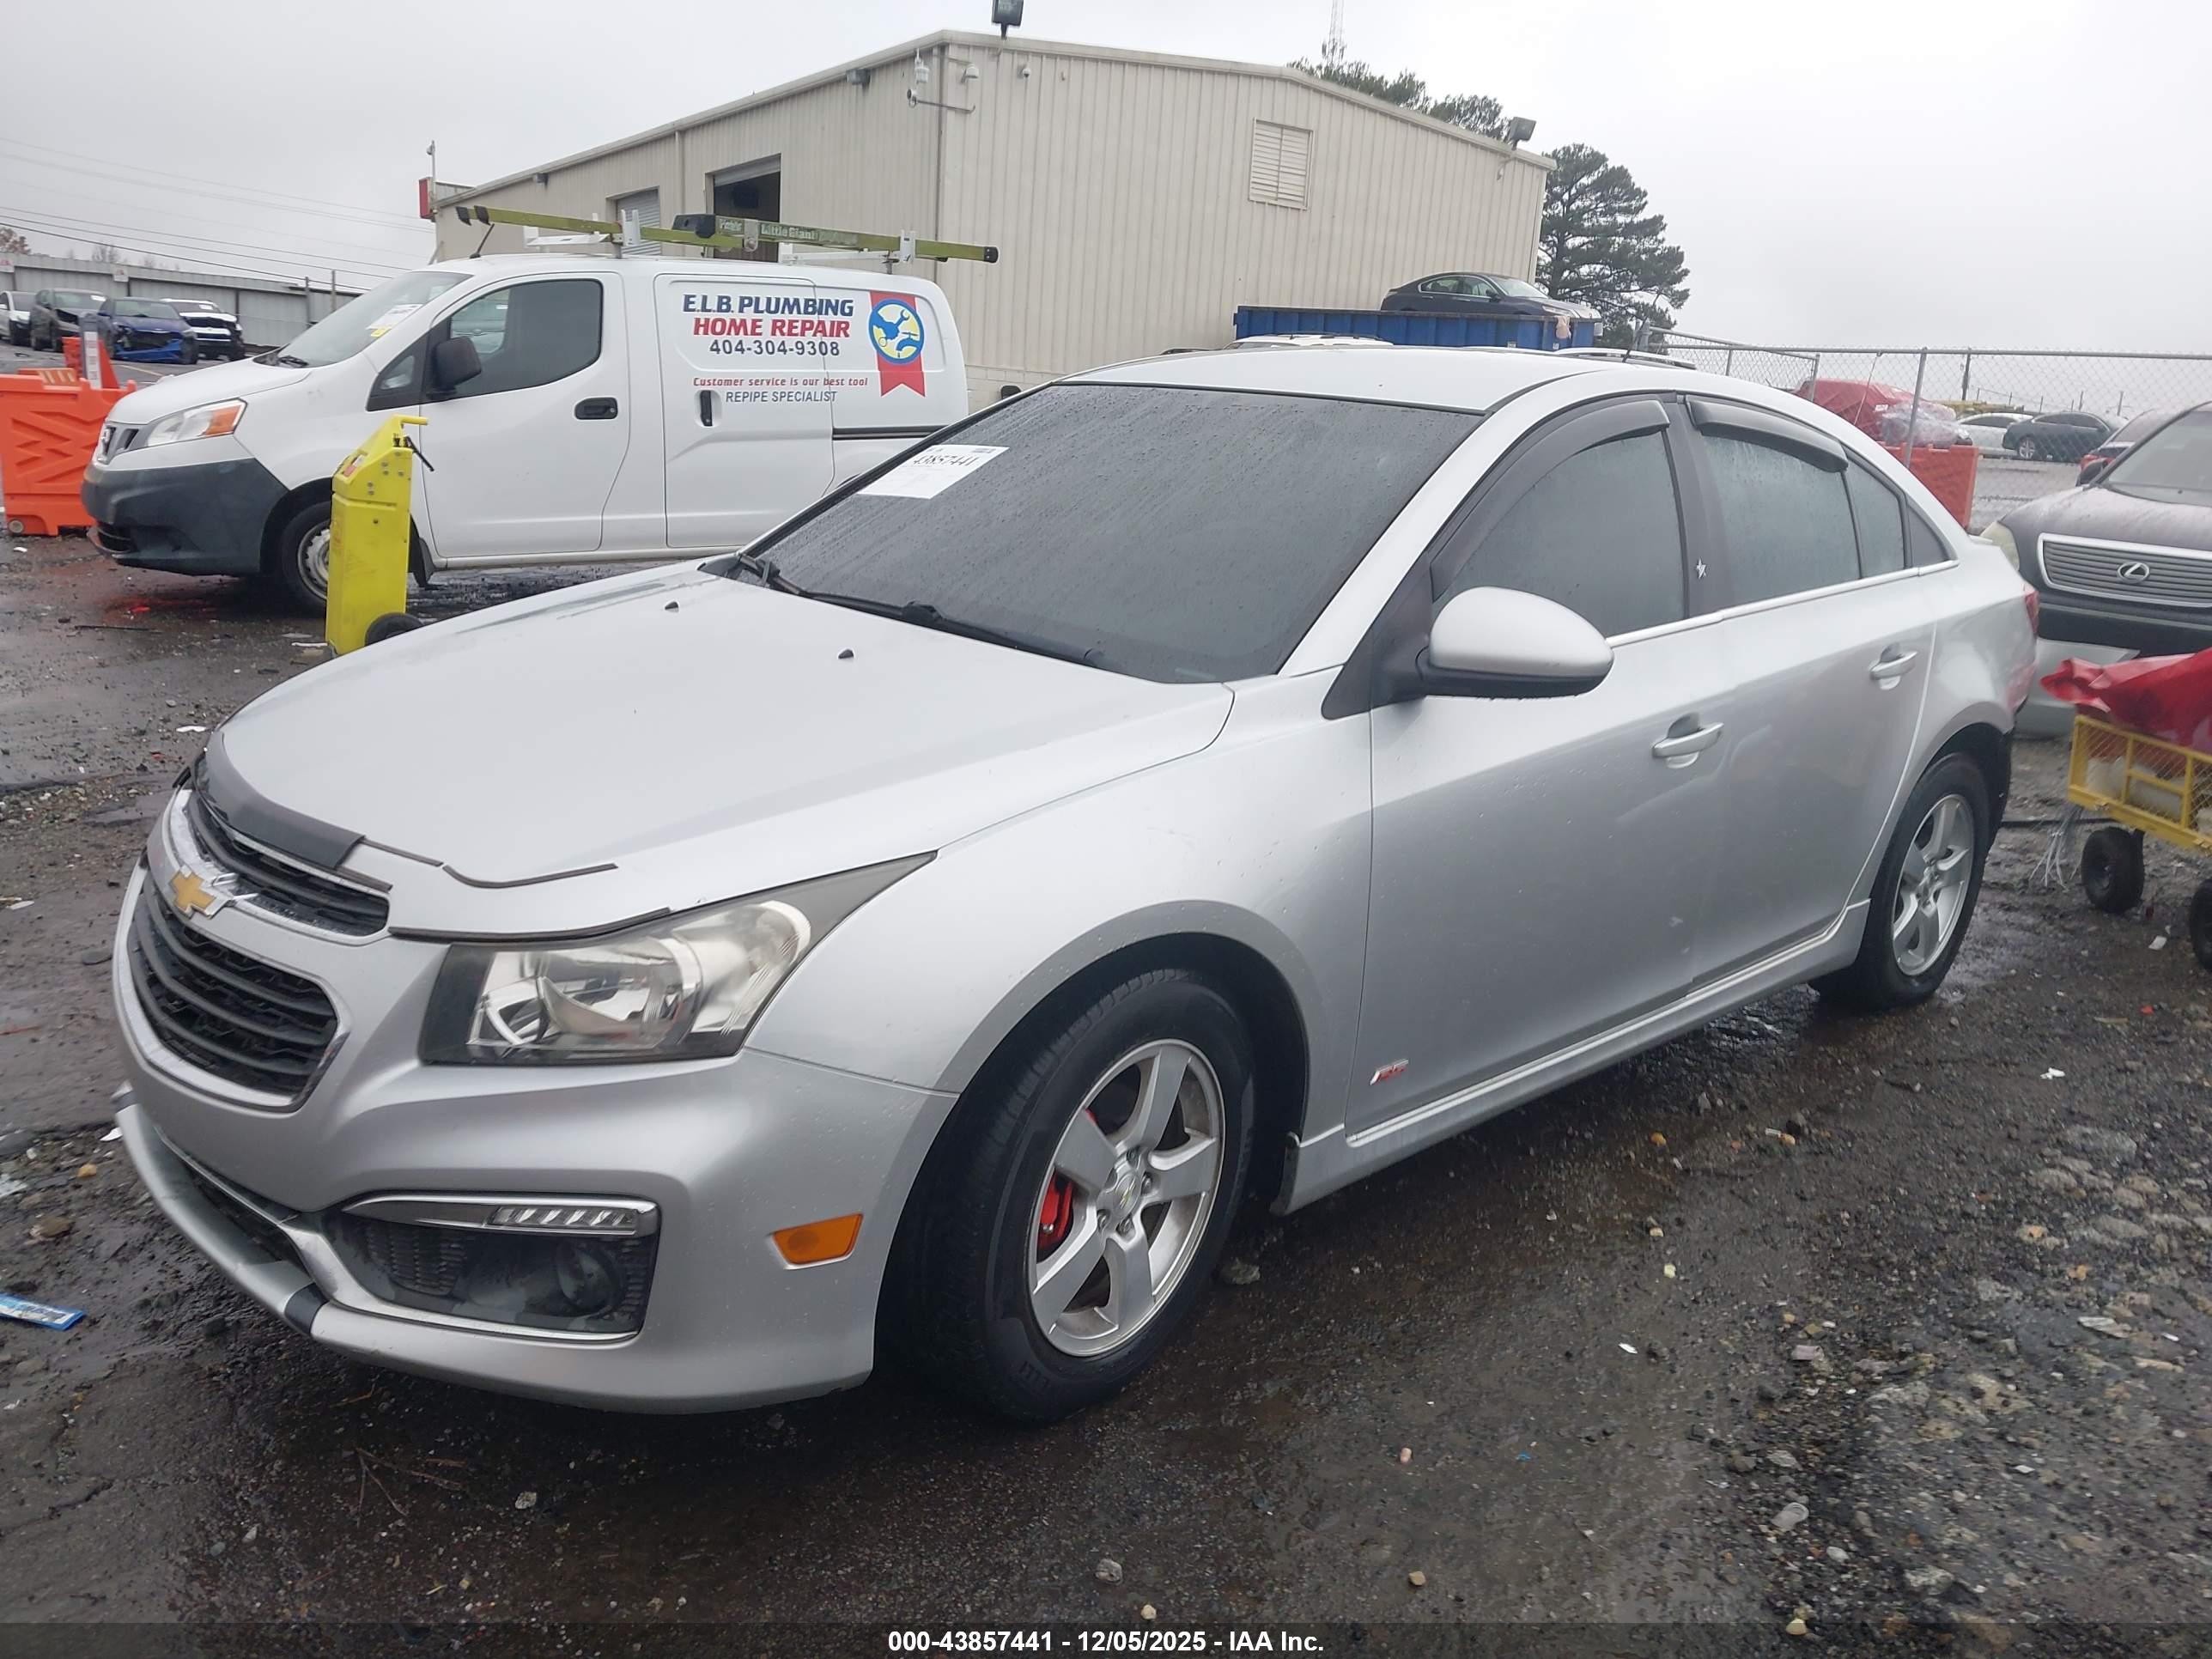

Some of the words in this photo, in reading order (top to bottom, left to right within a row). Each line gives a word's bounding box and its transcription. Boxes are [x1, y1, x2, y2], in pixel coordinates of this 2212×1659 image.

[683, 294, 734, 313] E.L.B.
[738, 295, 854, 317] PLUMBING
[693, 317, 763, 337] HOME
[770, 319, 850, 338] REPAIR
[709, 339, 840, 356] 404-304-9308
[693, 377, 744, 387] Customer
[748, 378, 787, 387] service
[790, 377, 799, 387] is
[802, 379, 819, 387] our
[823, 377, 846, 387] best
[848, 377, 868, 387] tool
[726, 391, 769, 403] REPIPE
[772, 391, 838, 404] SPECIALIST
